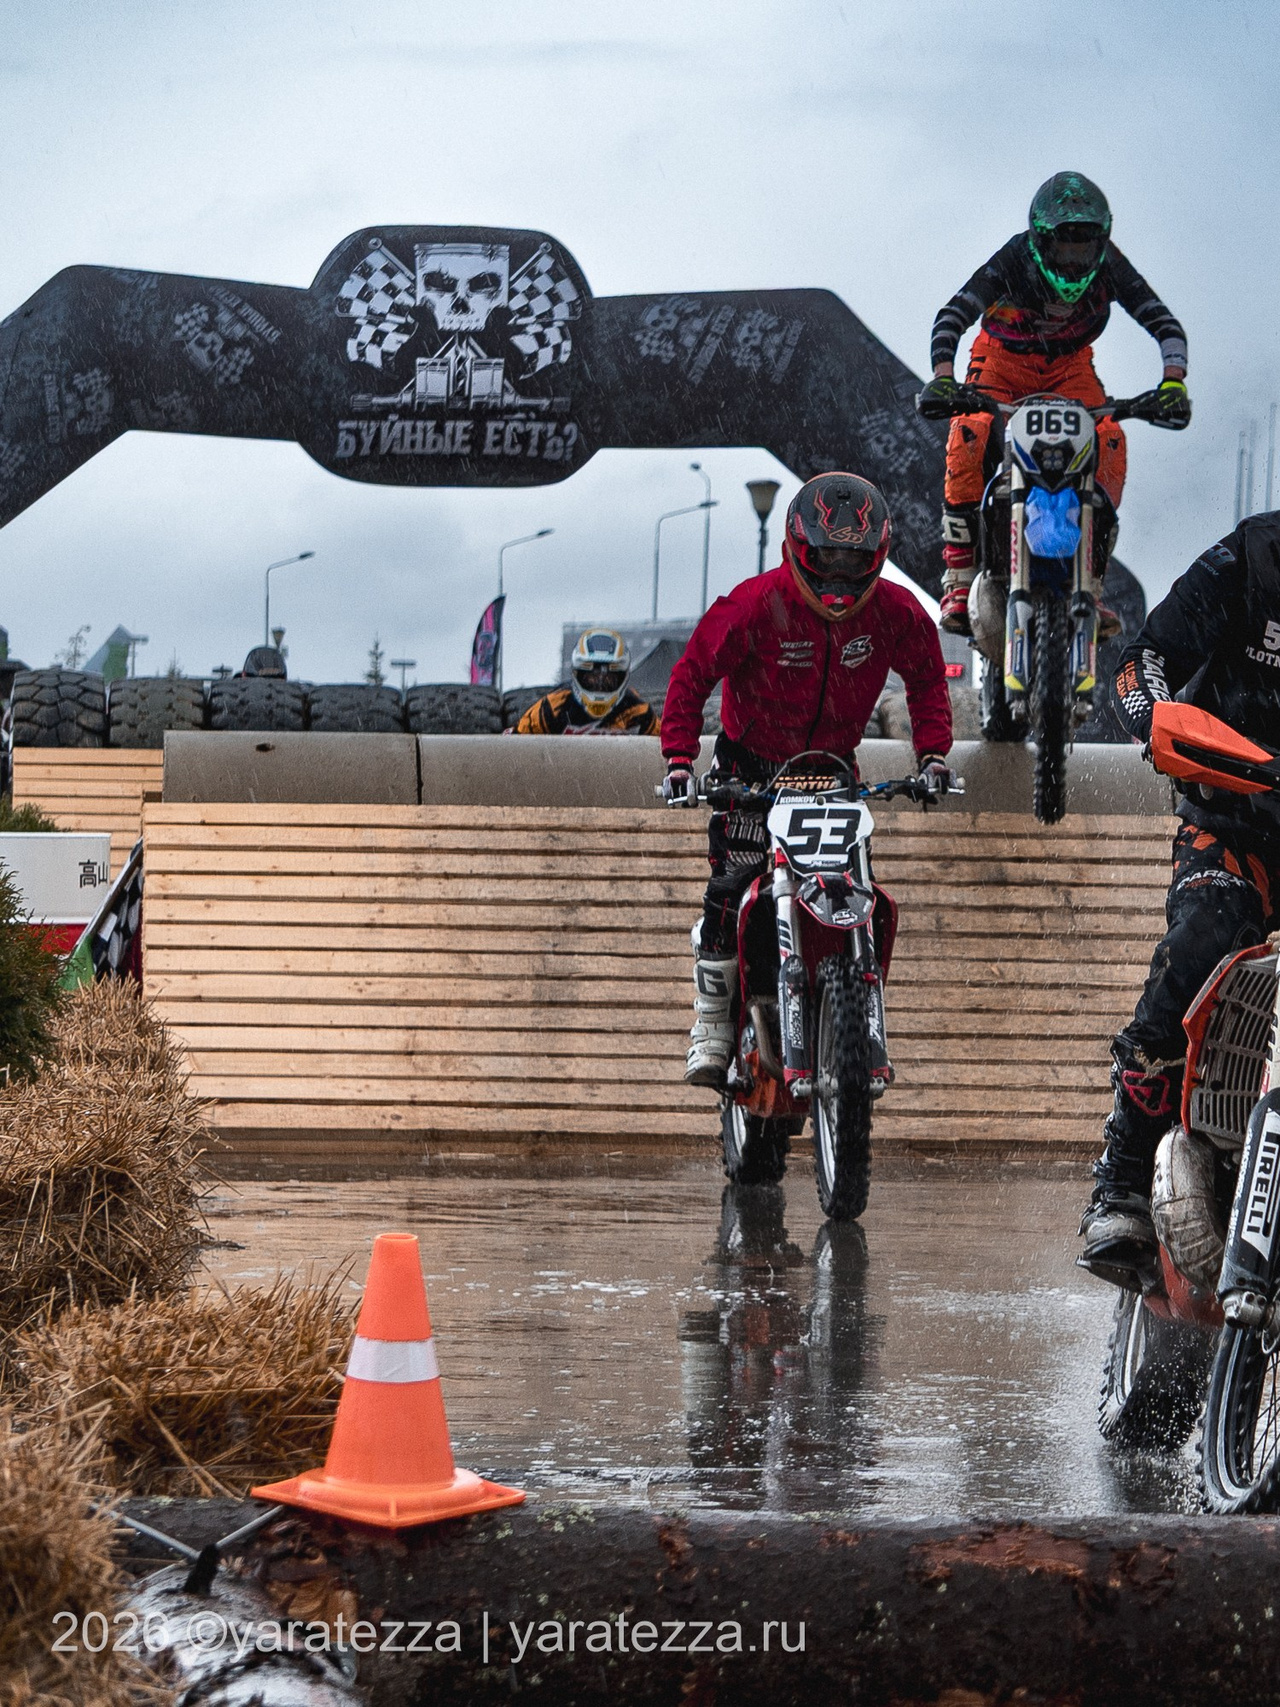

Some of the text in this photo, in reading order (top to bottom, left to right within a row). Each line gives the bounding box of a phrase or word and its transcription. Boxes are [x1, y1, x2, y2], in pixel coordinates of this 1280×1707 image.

[1026, 409, 1081, 437] 869
[335, 414, 578, 462] БУЙНЫЕ ЕСТЬ?
[774, 780, 841, 790] RENTHA
[780, 795, 815, 804] KOMKOV
[787, 808, 862, 855] 53
[78, 859, 109, 888] 高山
[1175, 869, 1246, 891] DAREX
